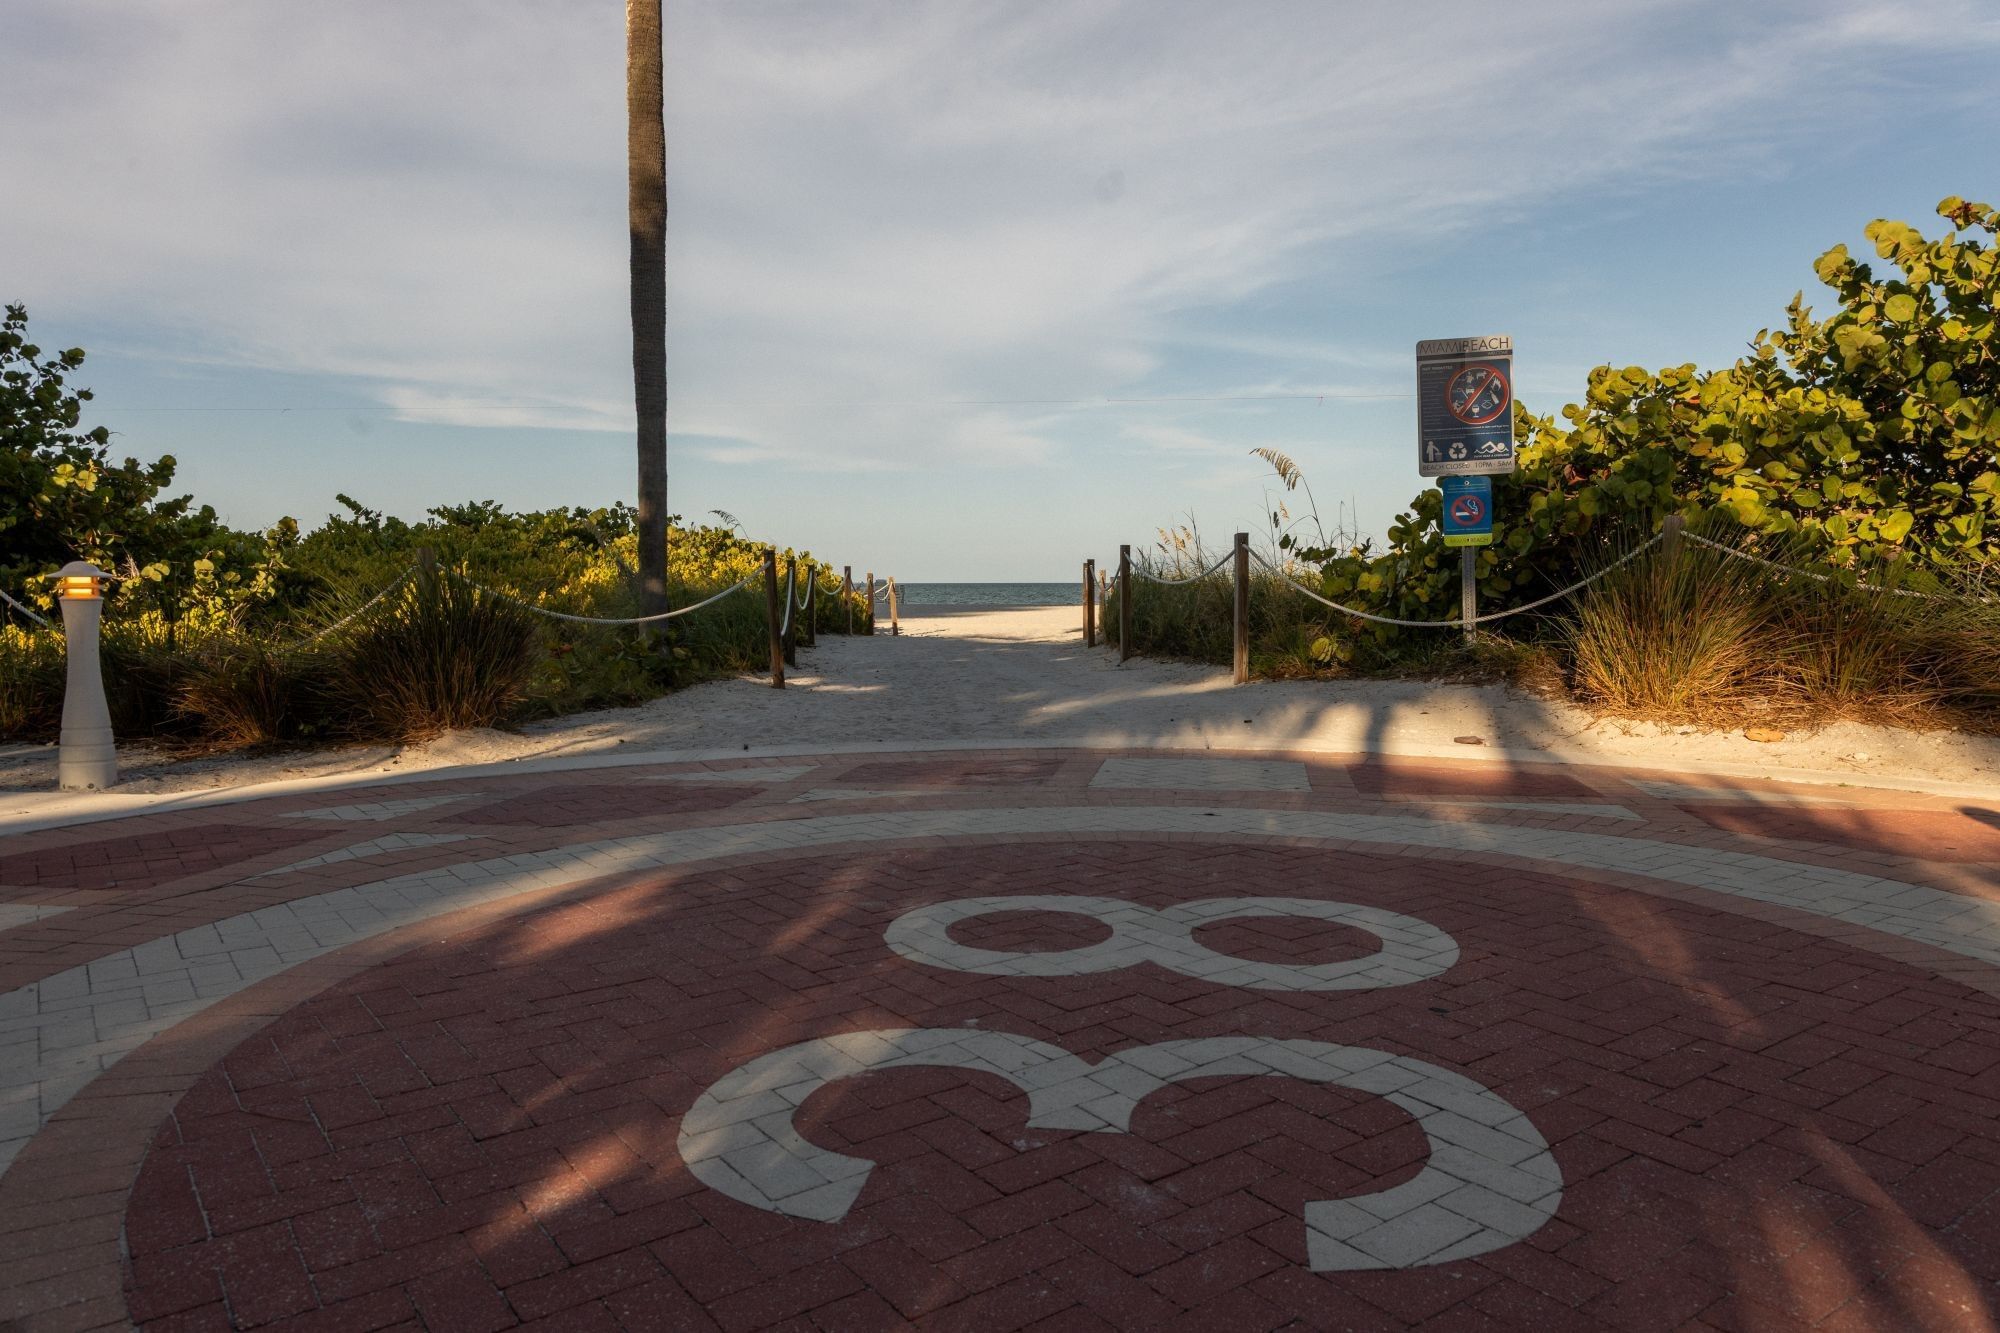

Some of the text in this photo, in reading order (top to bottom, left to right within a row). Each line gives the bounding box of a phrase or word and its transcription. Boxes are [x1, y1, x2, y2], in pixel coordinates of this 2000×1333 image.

[1423, 463, 1444, 471] BEACH
[1446, 462, 1470, 470] CLOSED
[1475, 461, 1493, 469] 10PM
